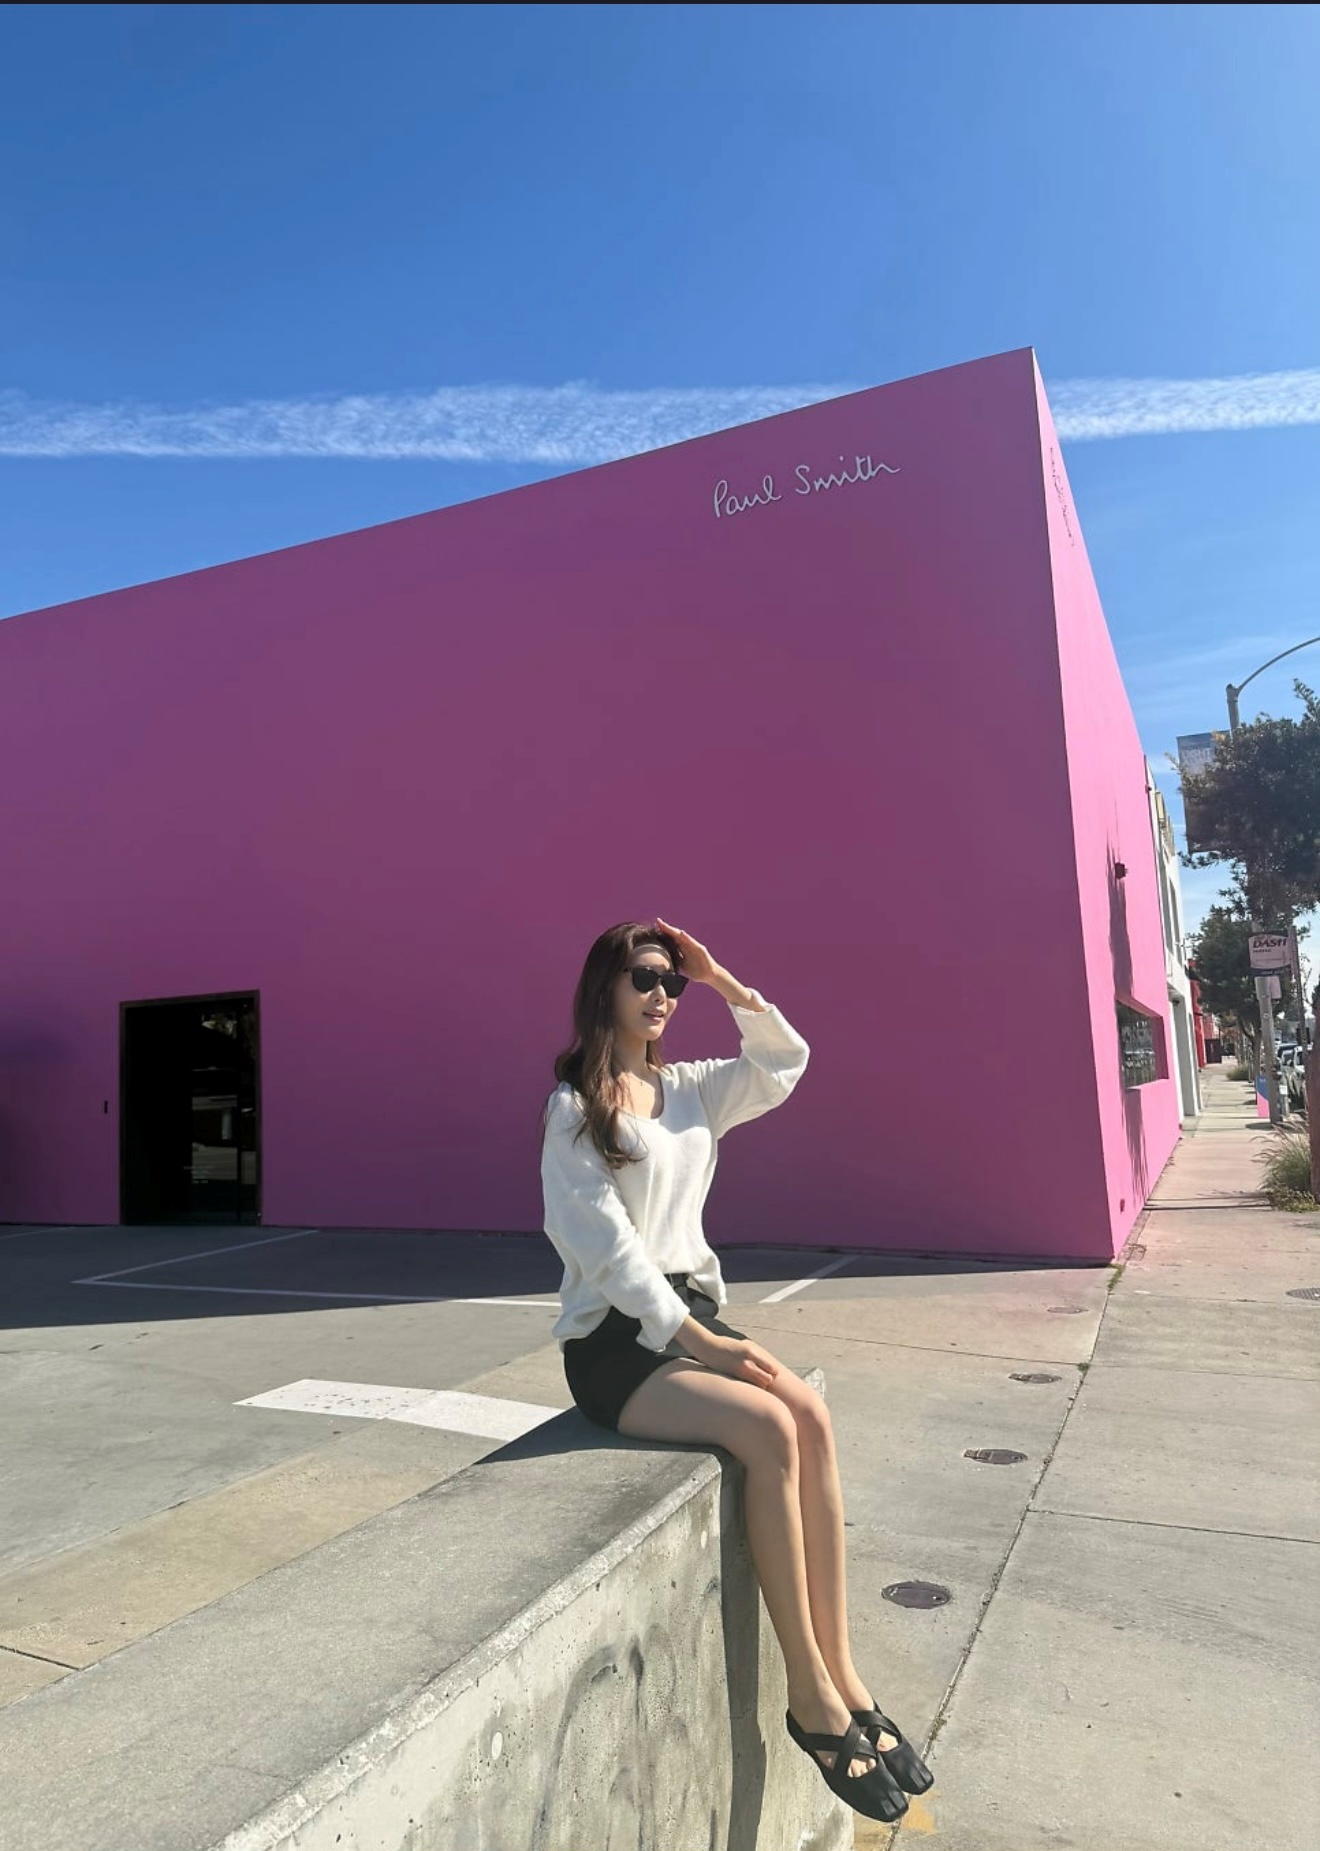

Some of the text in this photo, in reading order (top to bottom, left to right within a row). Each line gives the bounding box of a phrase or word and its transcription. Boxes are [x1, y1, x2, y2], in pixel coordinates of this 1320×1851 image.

[713, 455, 902, 519] Paul Smith
[1253, 938, 1287, 948] DASH
